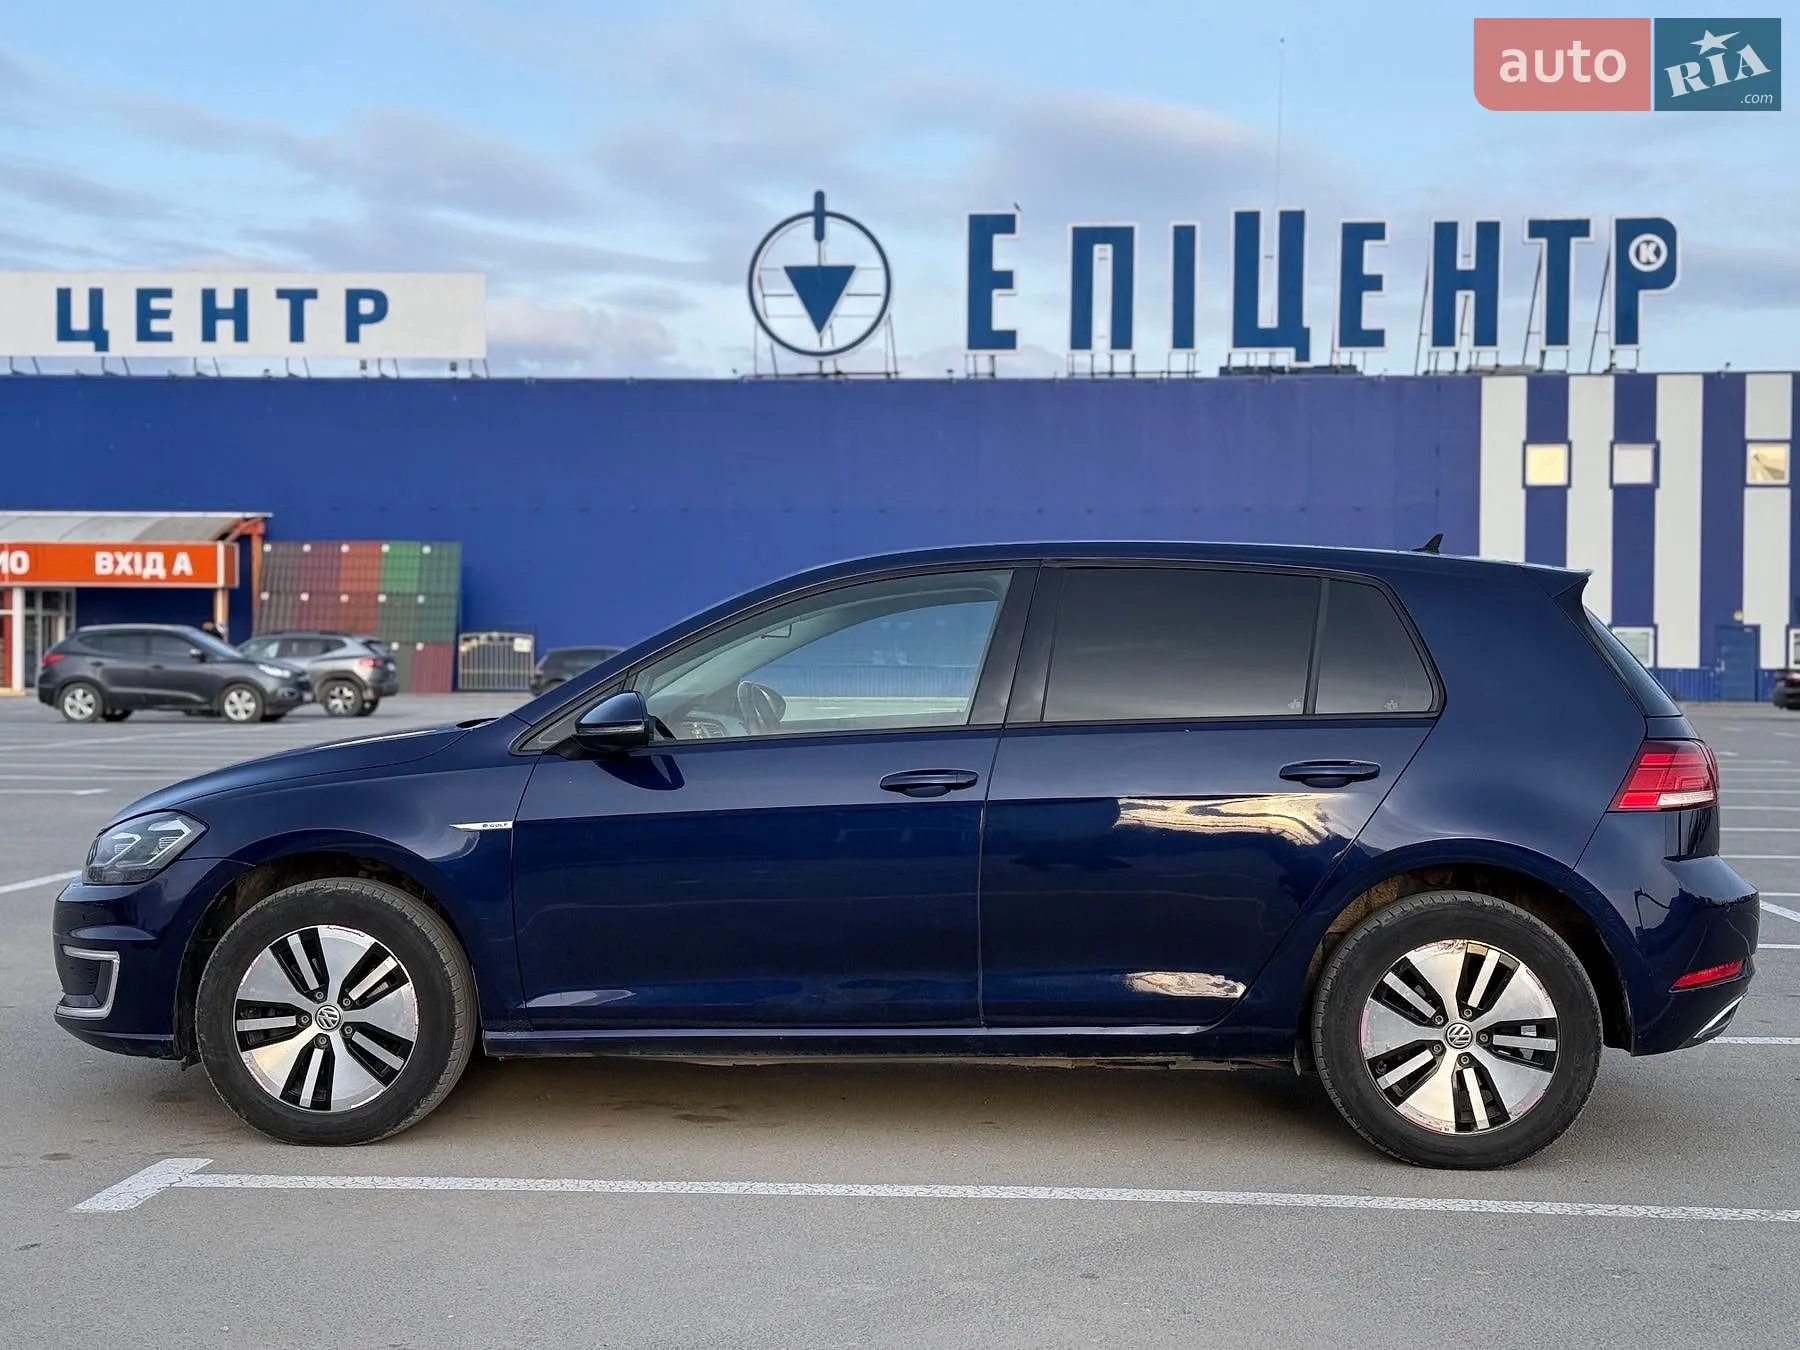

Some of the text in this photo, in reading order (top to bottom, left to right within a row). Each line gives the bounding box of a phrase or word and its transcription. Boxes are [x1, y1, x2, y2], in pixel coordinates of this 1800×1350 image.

[965, 208, 1679, 363] ЕПІЦЕНТР
[56, 287, 390, 352] ЦЕНТР
[94, 551, 194, 580] ВХІД А
